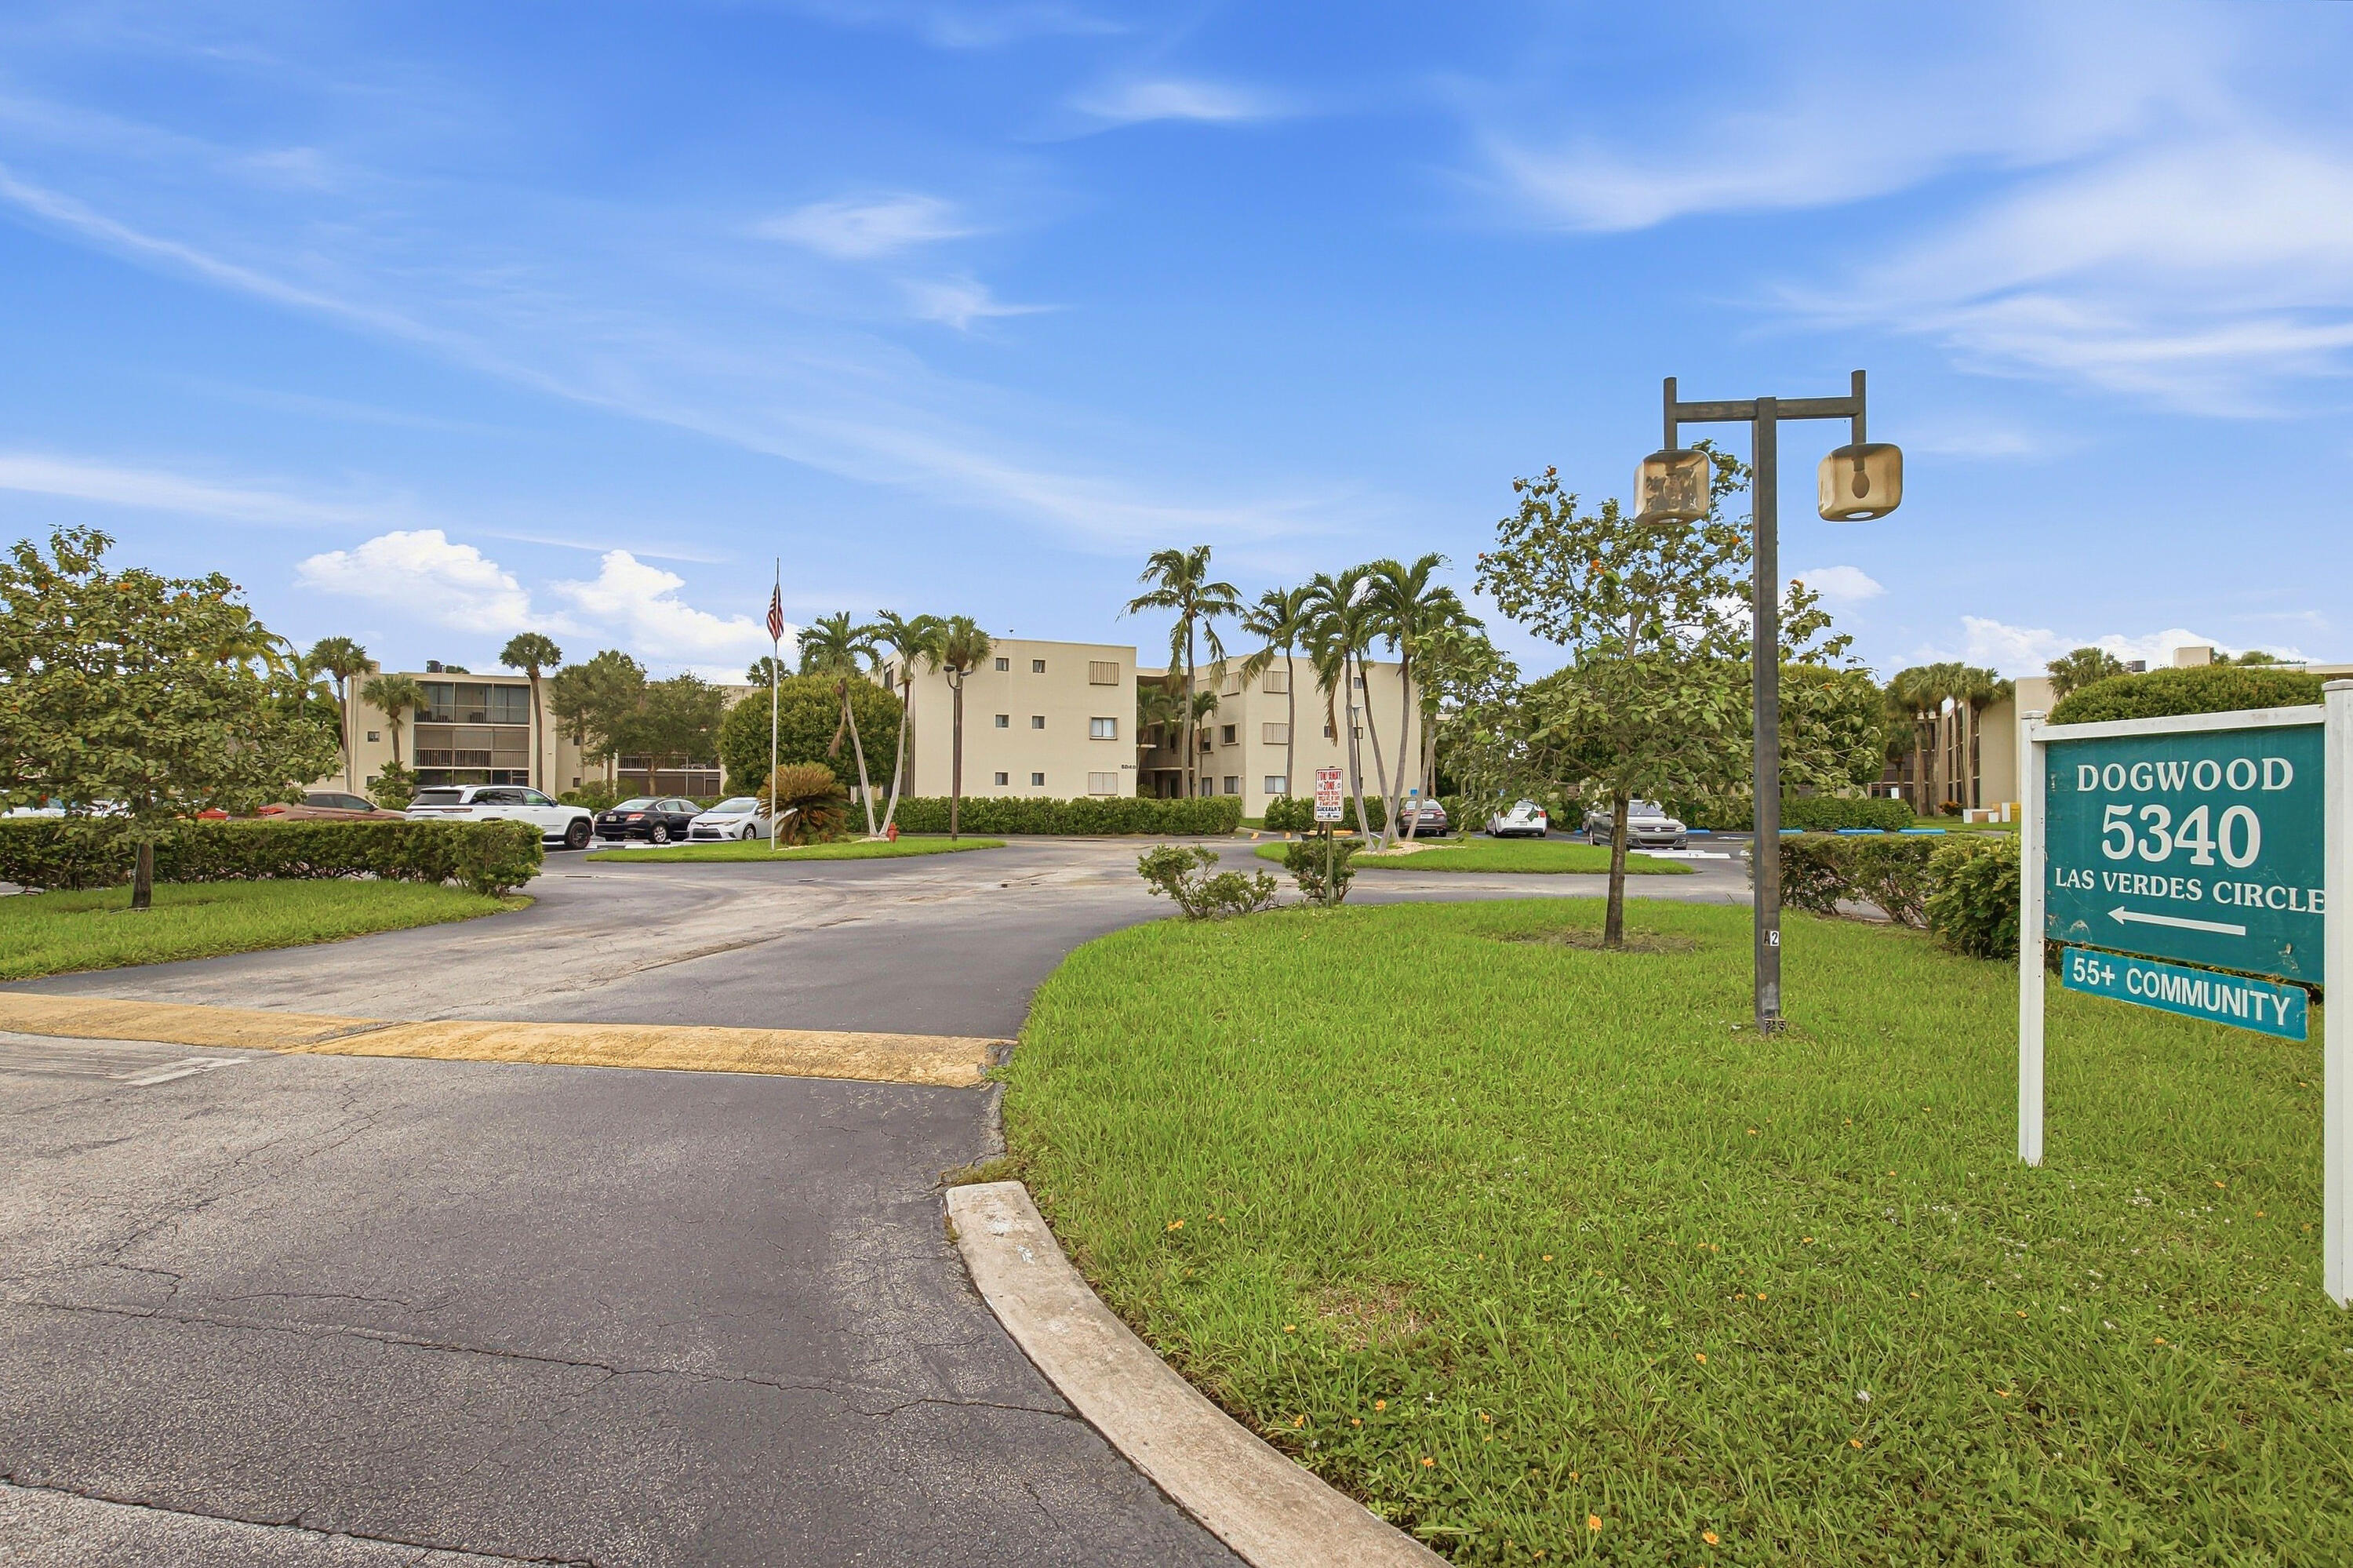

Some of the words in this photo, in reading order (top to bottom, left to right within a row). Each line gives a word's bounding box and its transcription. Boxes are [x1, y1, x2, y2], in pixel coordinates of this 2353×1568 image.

[2077, 758, 2293, 791] DOGWOOD
[2102, 804, 2261, 868] 5340
[2055, 868, 2095, 890] LAS
[2102, 871, 2202, 901] VERDES
[2213, 881, 2325, 914] CIRCLE
[1764, 930, 1778, 944] A2
[2073, 958, 2115, 986] 55+
[2126, 967, 2290, 1026] COMMUNITY
